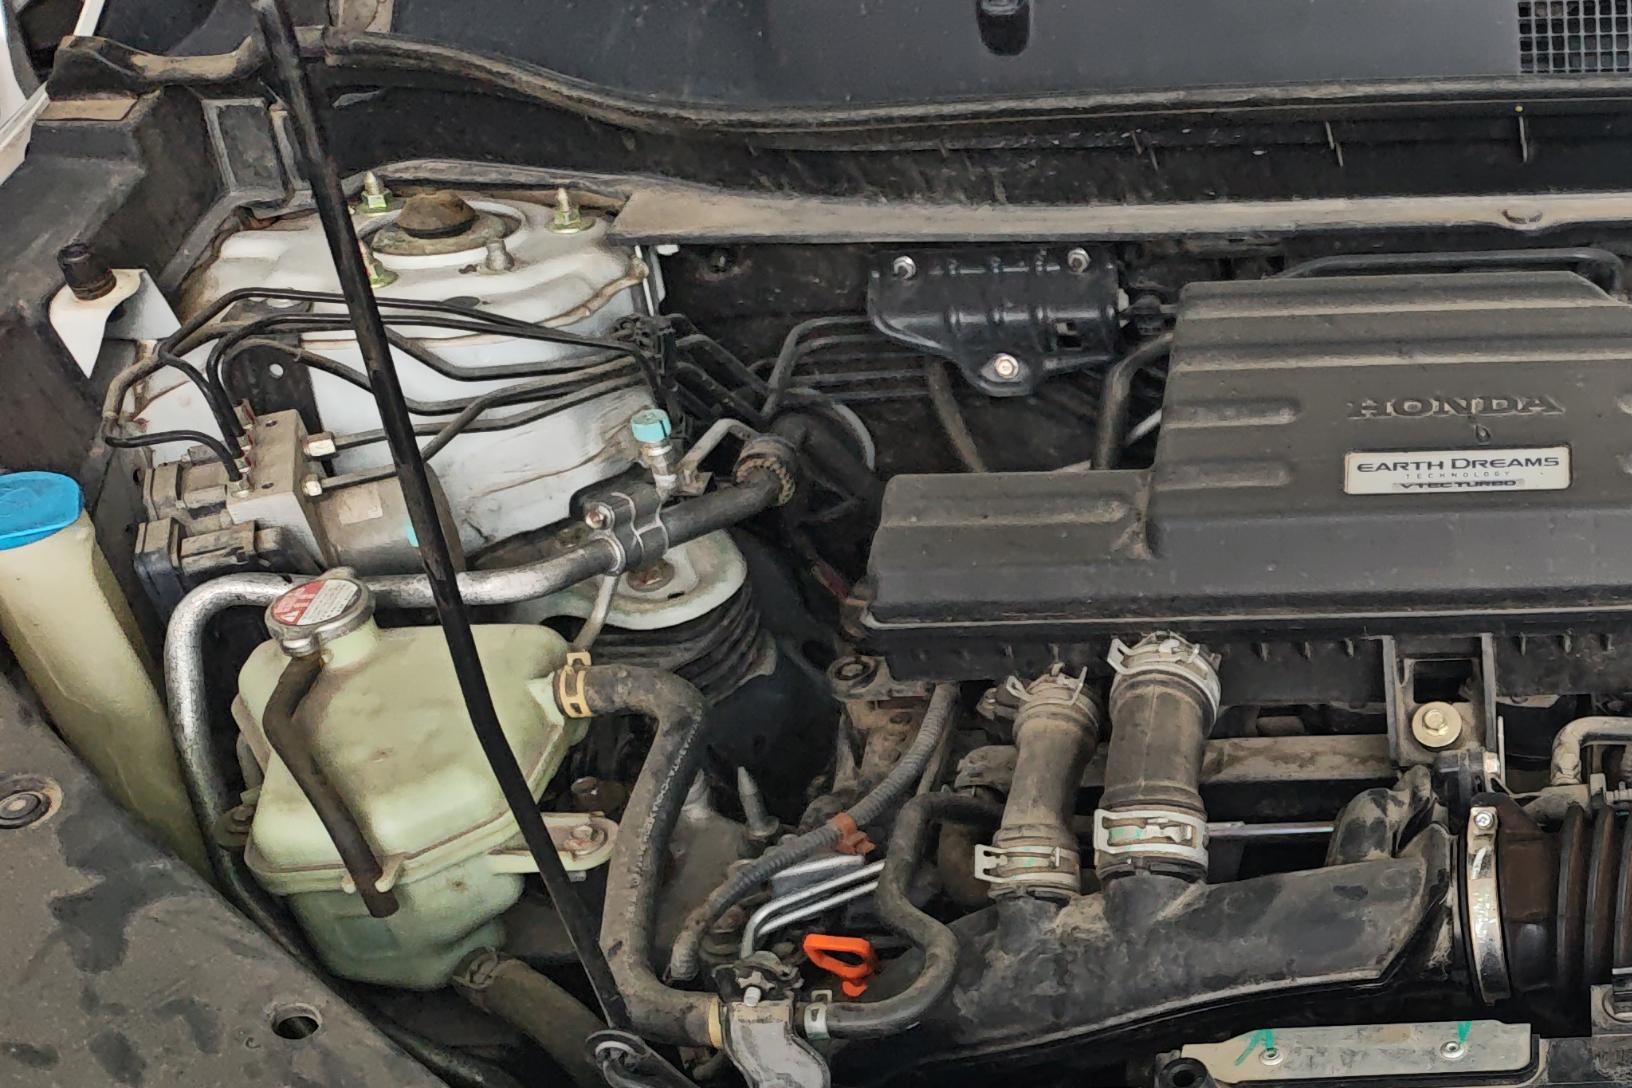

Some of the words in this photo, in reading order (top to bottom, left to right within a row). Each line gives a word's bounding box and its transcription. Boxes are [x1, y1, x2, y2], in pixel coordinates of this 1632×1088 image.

[1346, 394, 1566, 418] HONDA
[1356, 461, 1444, 473] EARTH
[1450, 456, 1560, 470] DREAMS
[1405, 470, 1512, 479] TECHNOLOGY
